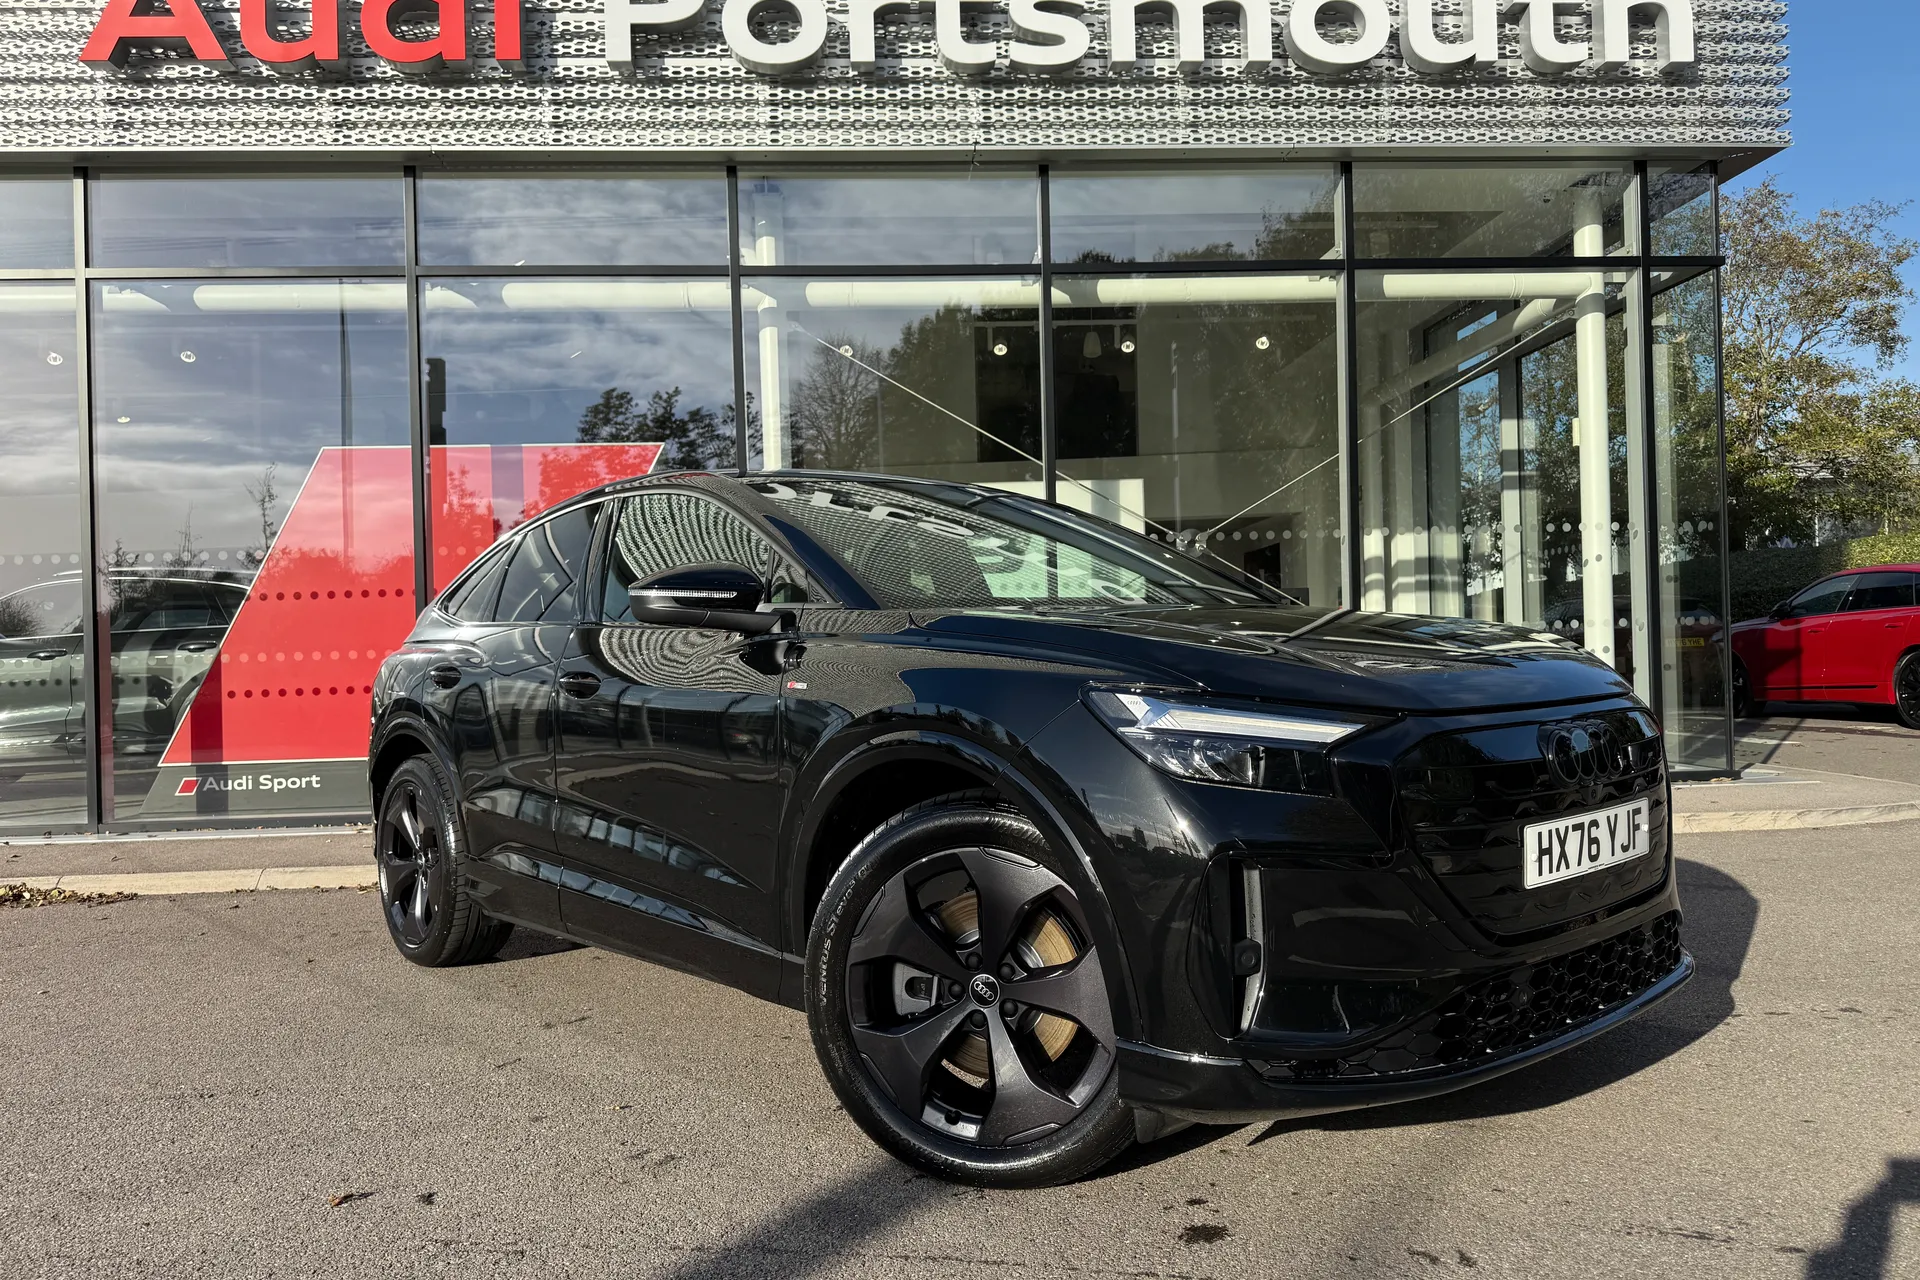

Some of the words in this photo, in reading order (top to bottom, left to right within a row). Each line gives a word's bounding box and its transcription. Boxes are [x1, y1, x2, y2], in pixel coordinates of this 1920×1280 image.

[605, 0, 1696, 65] Portsmouth
[202, 775, 253, 791] Audi
[259, 774, 321, 792] Sport
[1537, 818, 1601, 877] HX76
[1606, 806, 1642, 857] YJF
